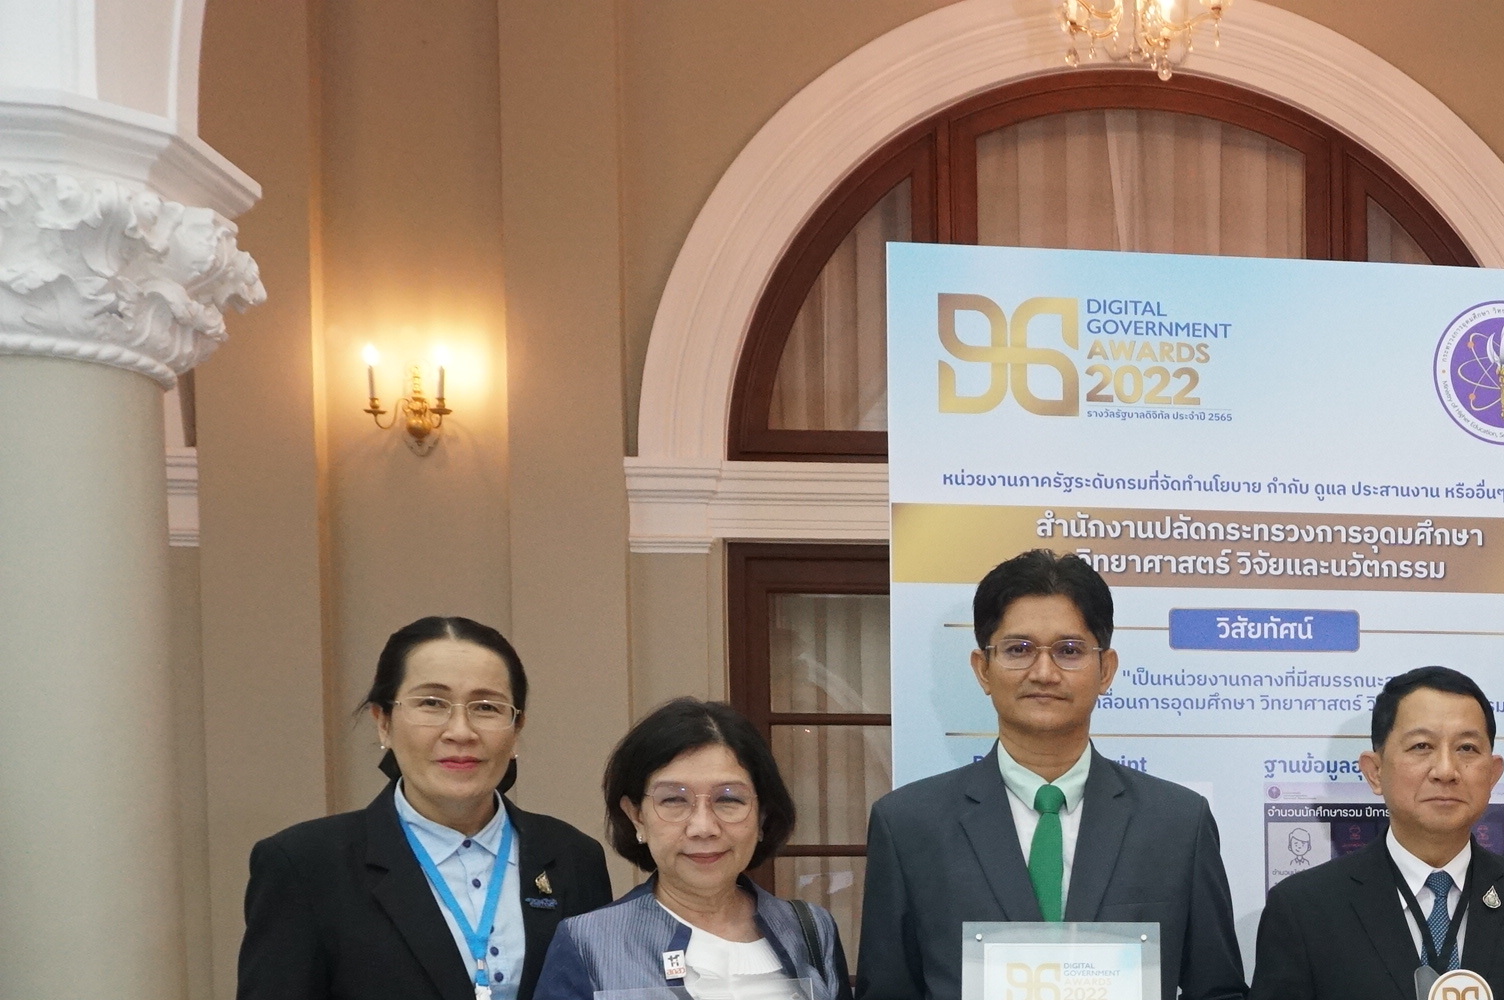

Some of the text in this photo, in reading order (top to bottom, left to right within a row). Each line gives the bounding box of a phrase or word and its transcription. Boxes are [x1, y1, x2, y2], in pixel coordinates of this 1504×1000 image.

[1086, 299, 1167, 317] DIGITAL
[1086, 319, 1232, 338] GOVERNMENT
[1086, 339, 1210, 363] AWARDS
[1085, 364, 1201, 405] 2022
[1172, 410, 1206, 421] ประจำปี
[1208, 413, 1233, 421] 2565
[942, 469, 1262, 493] หน่วยงานภาครัฐระดับกรมที่จัดทำนโยบาย
[1267, 476, 1309, 495] กำกับ
[1314, 481, 1346, 501] ดูแล
[1351, 481, 1440, 499] ประสานงาน
[1036, 509, 1484, 553] สำนักงานปลัดกระทรวงการอุดมศึกษา
[1236, 550, 1445, 579] วิจัยและนวัตกรรม
[1216, 615, 1314, 640] วิสัยทัศน์
[1260, 694, 1362, 712] วิทยาศาสตร์
[1267, 806, 1362, 817] จำนวนนักศึกษารวม
[1063, 969, 1121, 977] GOVERNMENT
